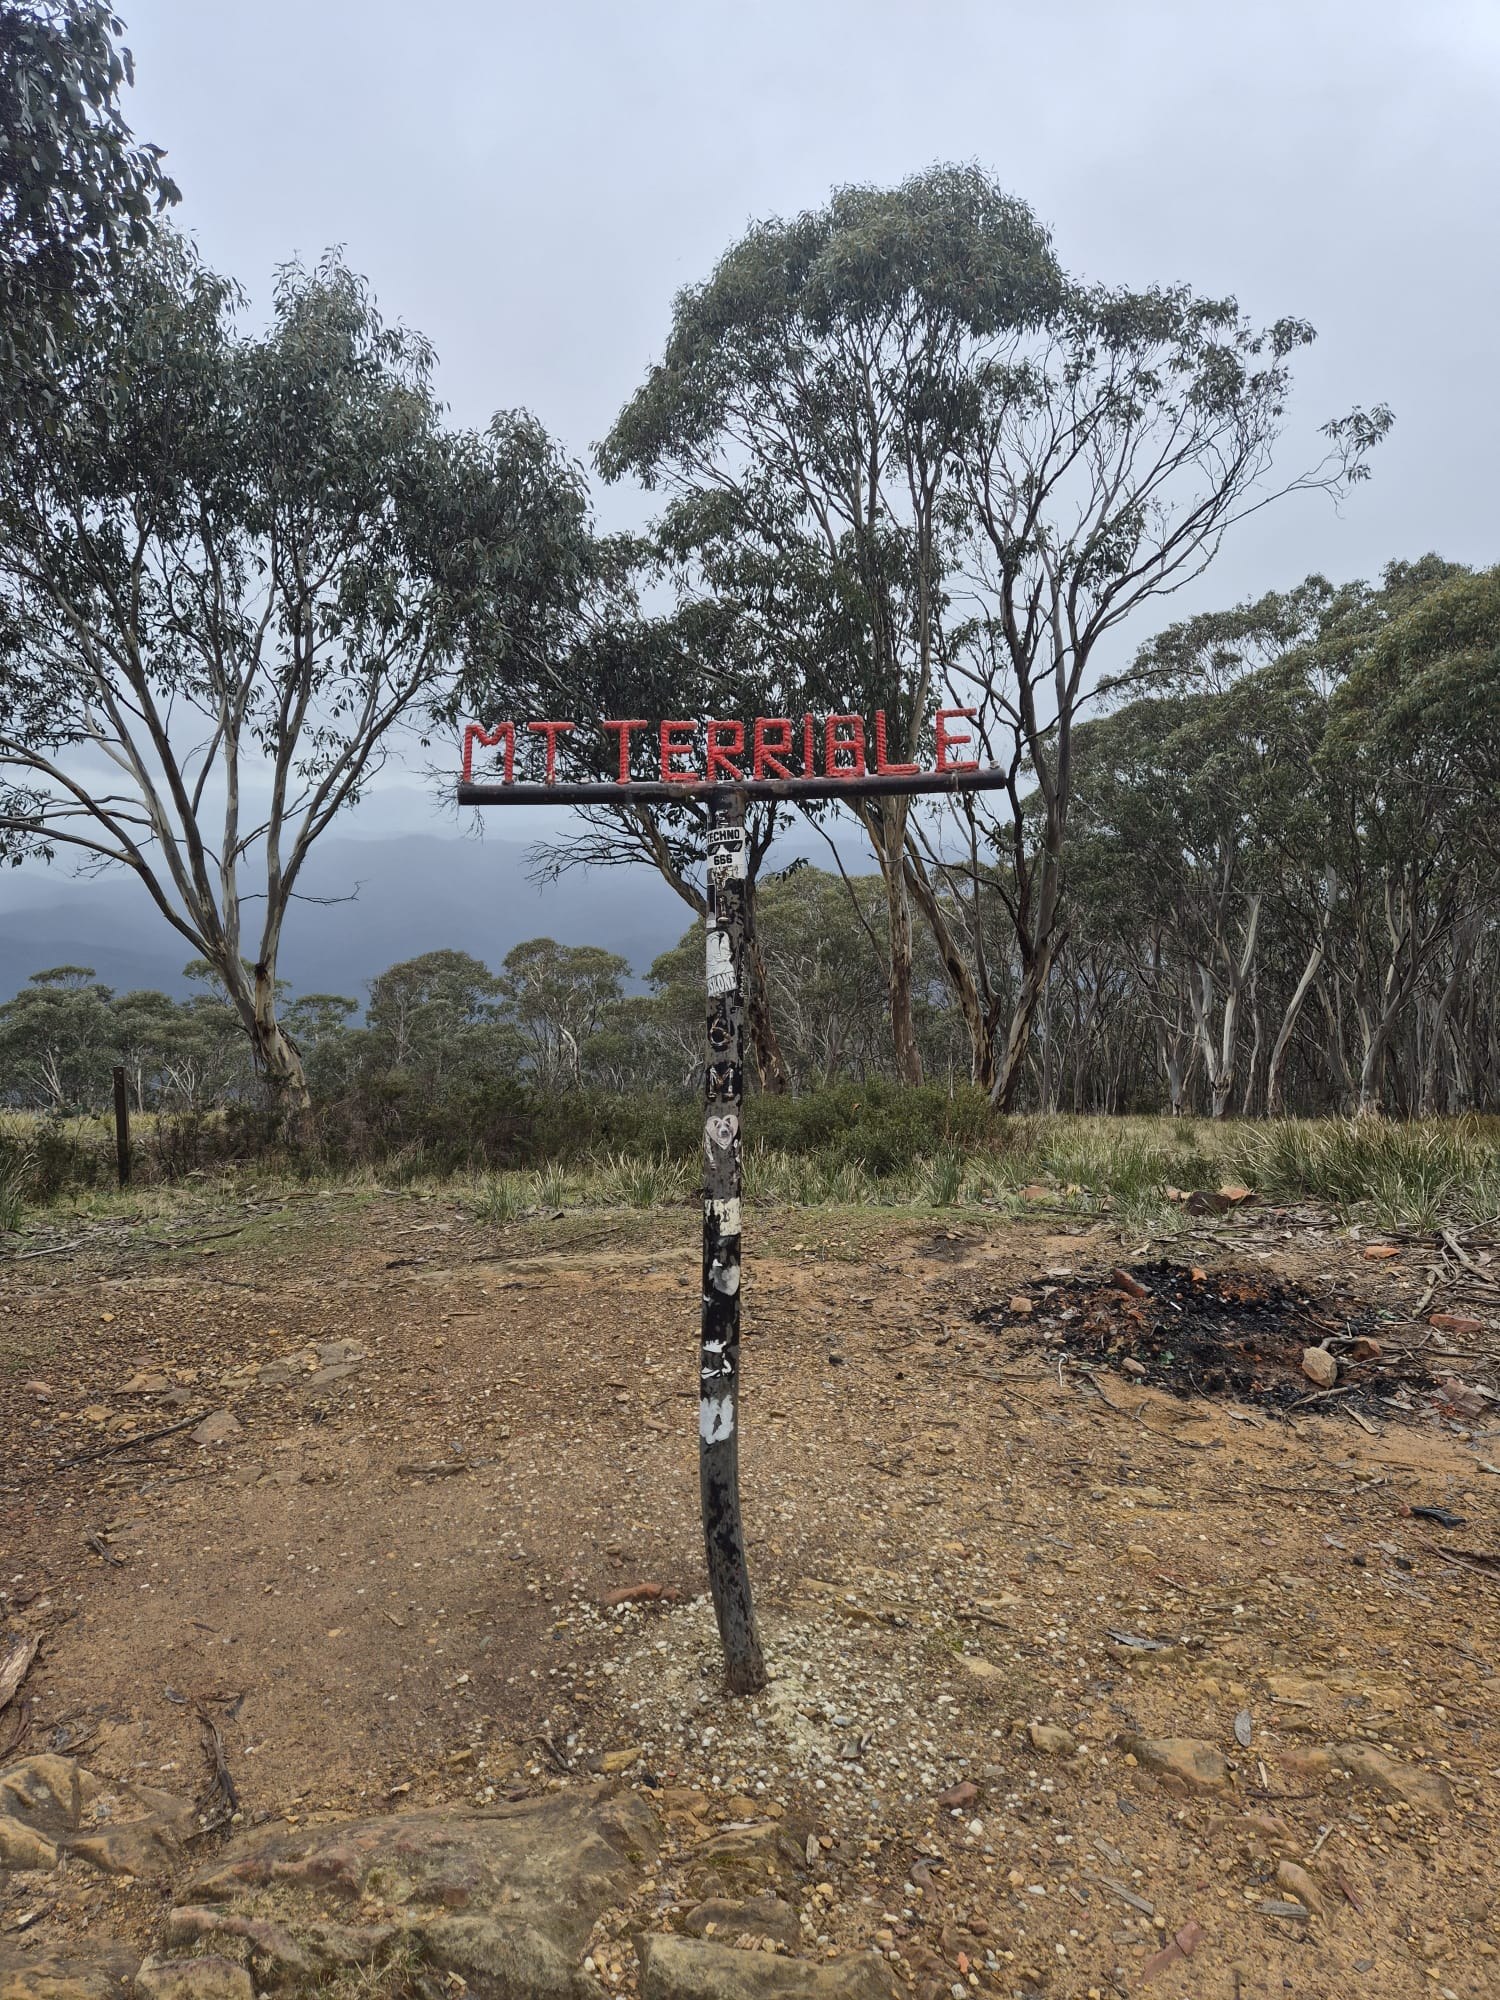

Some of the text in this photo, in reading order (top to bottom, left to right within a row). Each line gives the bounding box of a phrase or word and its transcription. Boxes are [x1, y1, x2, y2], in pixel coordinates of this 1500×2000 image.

[463, 709, 979, 784] MT TERRIBLE
[708, 828, 740, 843] TECHNO
[713, 854, 733, 866] 666
